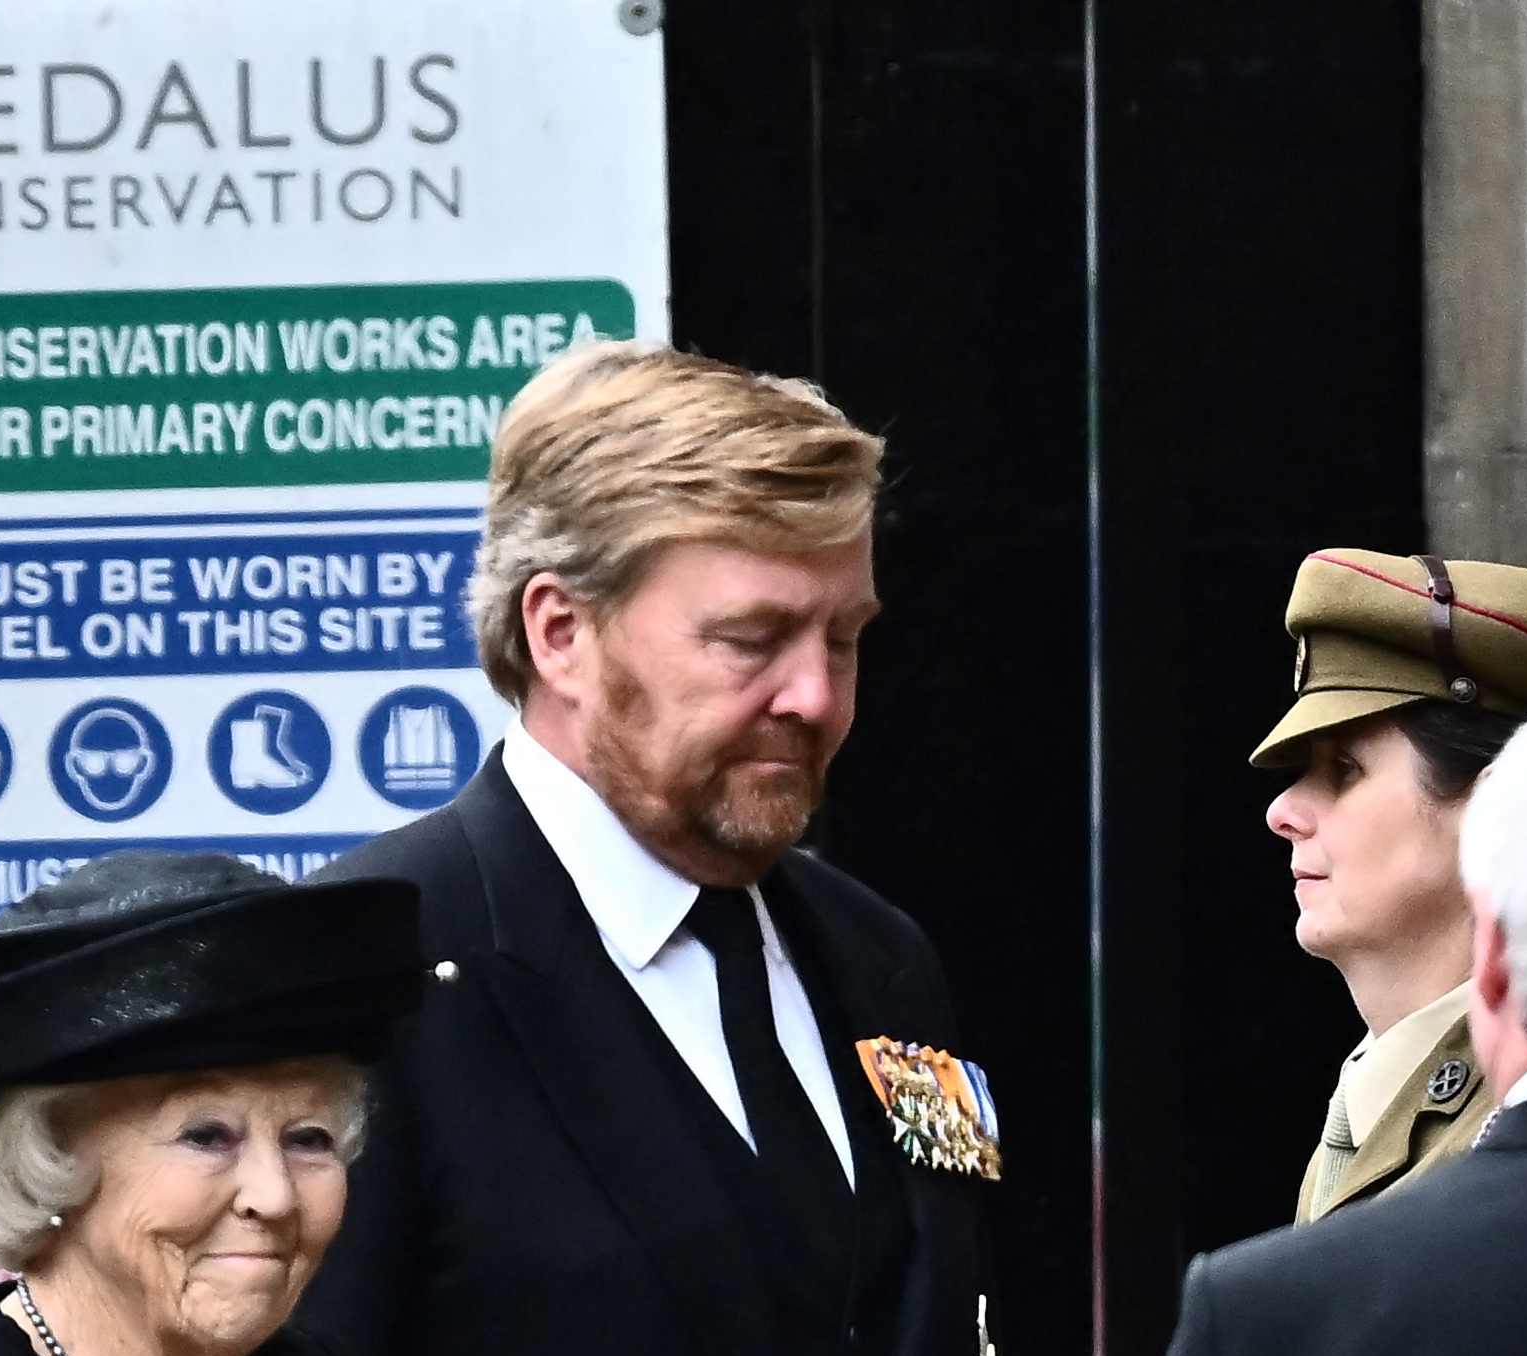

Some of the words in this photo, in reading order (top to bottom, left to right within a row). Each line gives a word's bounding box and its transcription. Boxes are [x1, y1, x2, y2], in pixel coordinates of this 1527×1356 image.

[278, 316, 460, 375] WORKS
[466, 311, 598, 369] AREA
[40, 400, 255, 458] PRIMARY
[263, 394, 503, 452] CONCERN
[99, 557, 175, 604] BE
[188, 554, 367, 601] WORN
[377, 551, 454, 598] BY
[81, 612, 165, 660] ON
[178, 607, 308, 656] THIS
[319, 605, 445, 654] SITE
